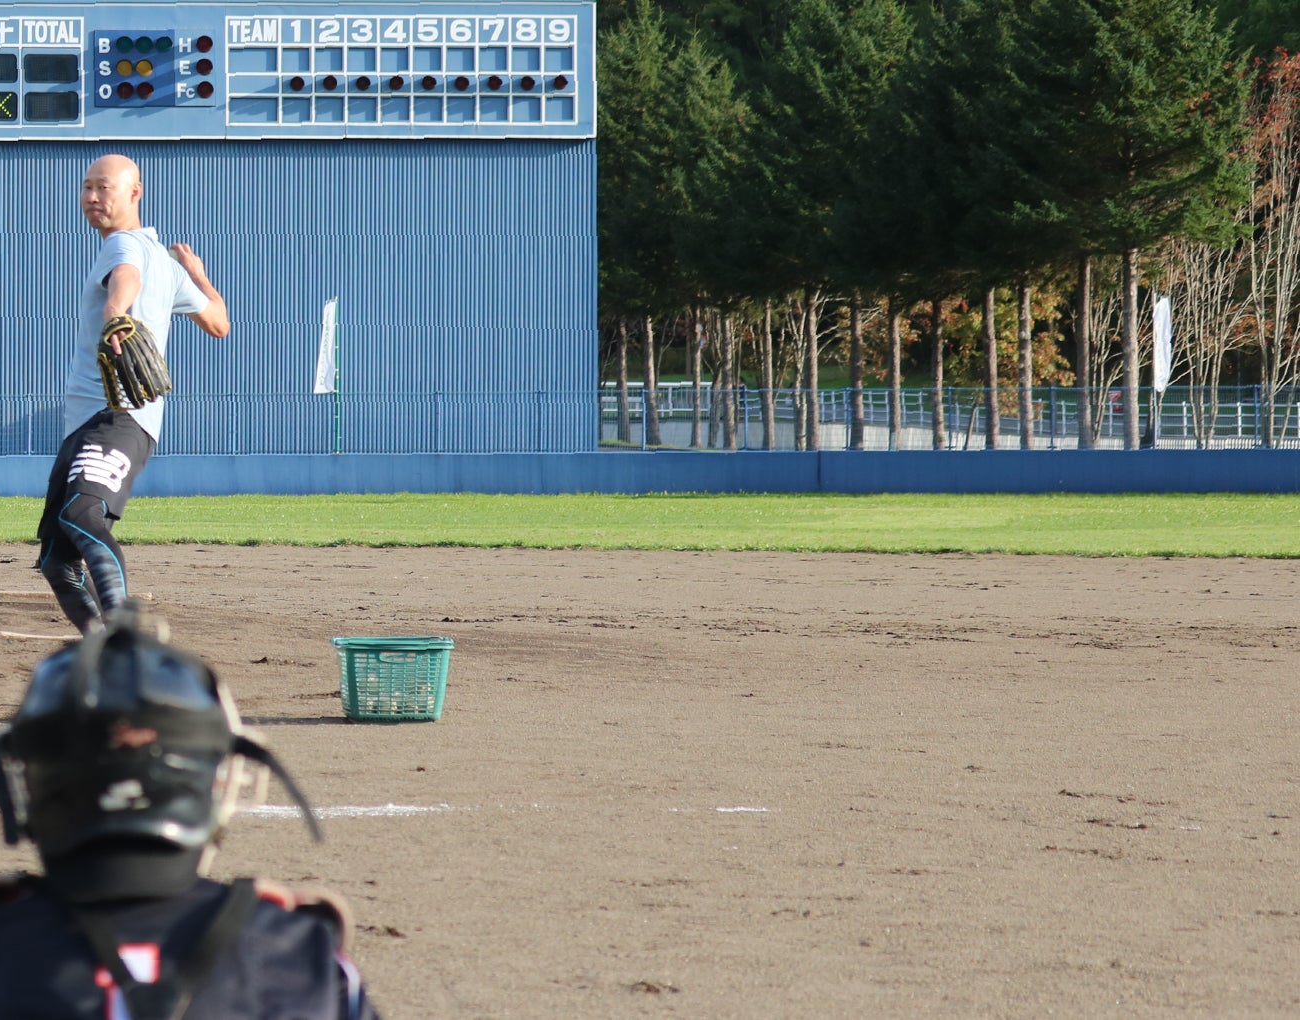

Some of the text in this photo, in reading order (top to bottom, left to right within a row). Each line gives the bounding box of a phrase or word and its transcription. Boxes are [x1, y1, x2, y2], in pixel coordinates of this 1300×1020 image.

[24, 21, 79, 43] TOTAL
[229, 19, 570, 42] TEAM 1 2 3 4 5 6 7 8 9
[98, 38, 111, 53] B
[178, 38, 191, 52] H
[99, 61, 111, 76] S
[179, 60, 191, 75] E
[99, 84, 112, 99] O
